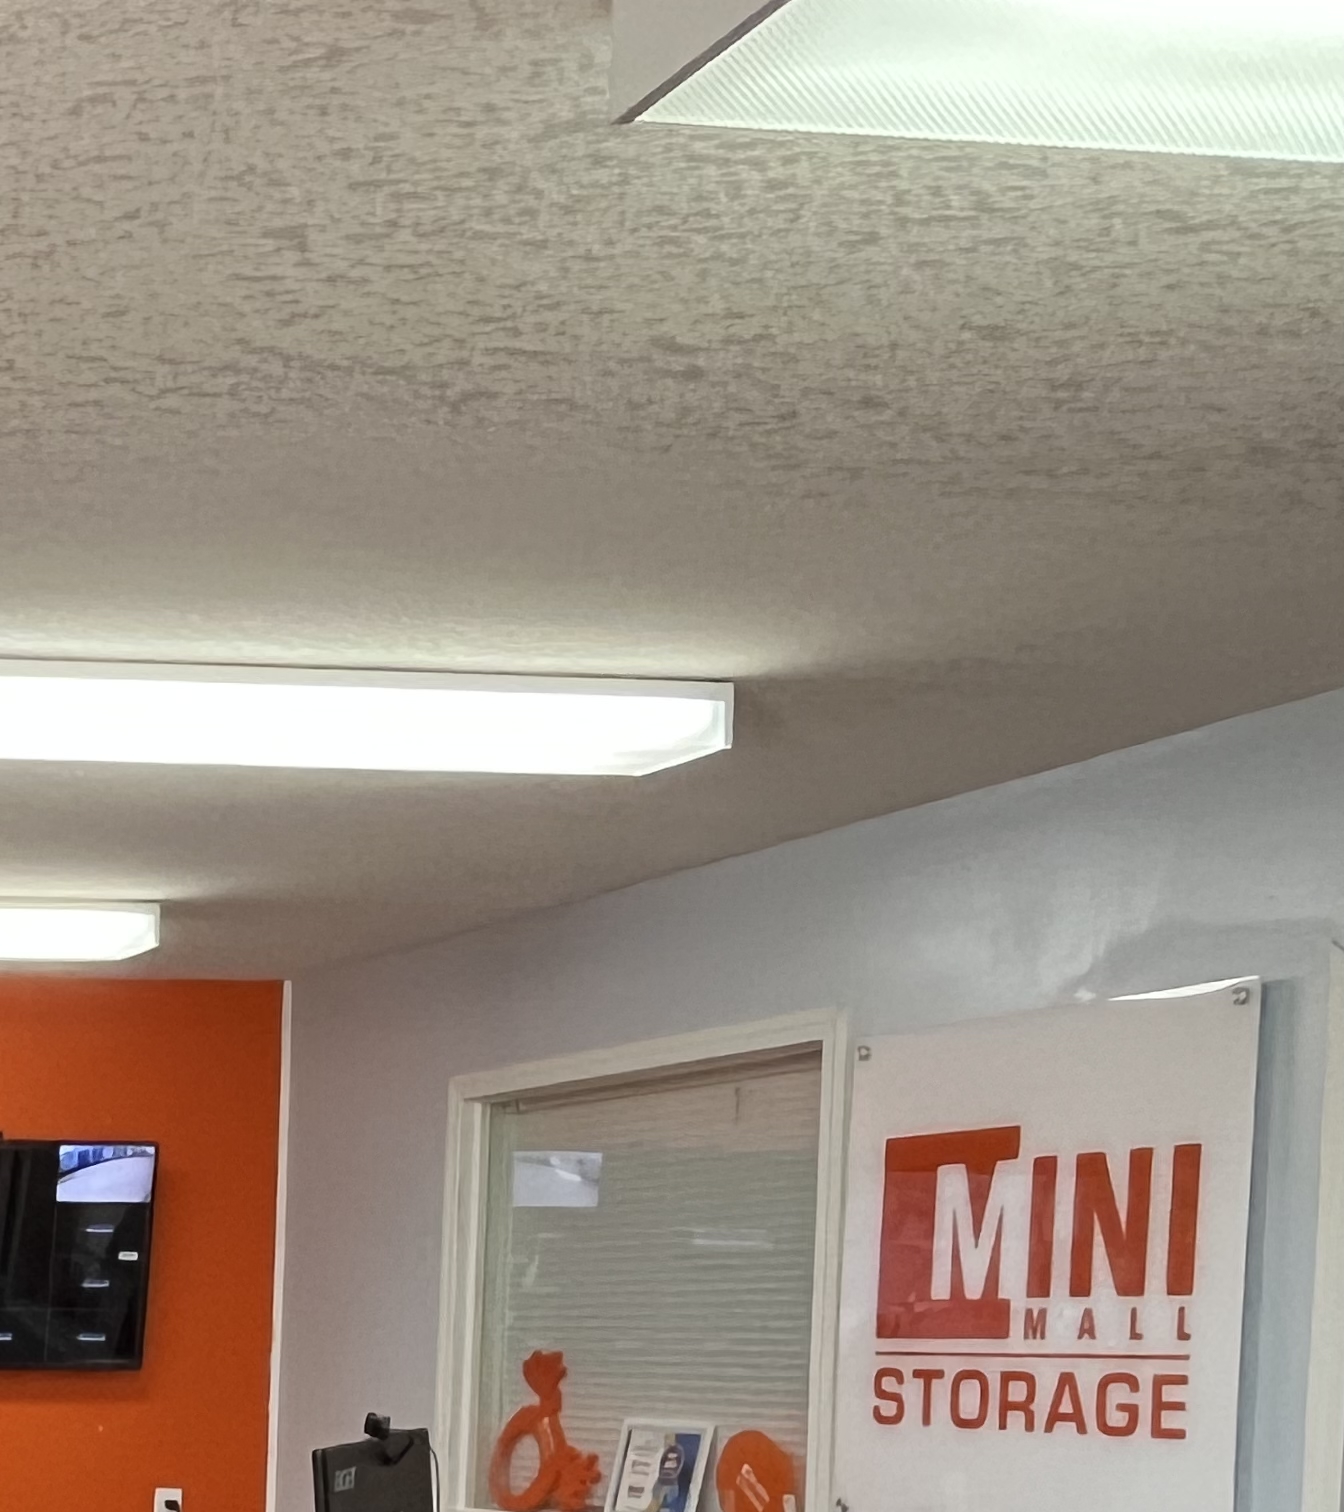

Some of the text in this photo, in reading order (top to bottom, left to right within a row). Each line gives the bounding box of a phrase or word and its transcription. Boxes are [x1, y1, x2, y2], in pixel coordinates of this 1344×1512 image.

[927, 1140, 1203, 1302] MINI
[1022, 1305, 1192, 1341] MALL
[871, 1366, 1191, 1441] STORAGE
